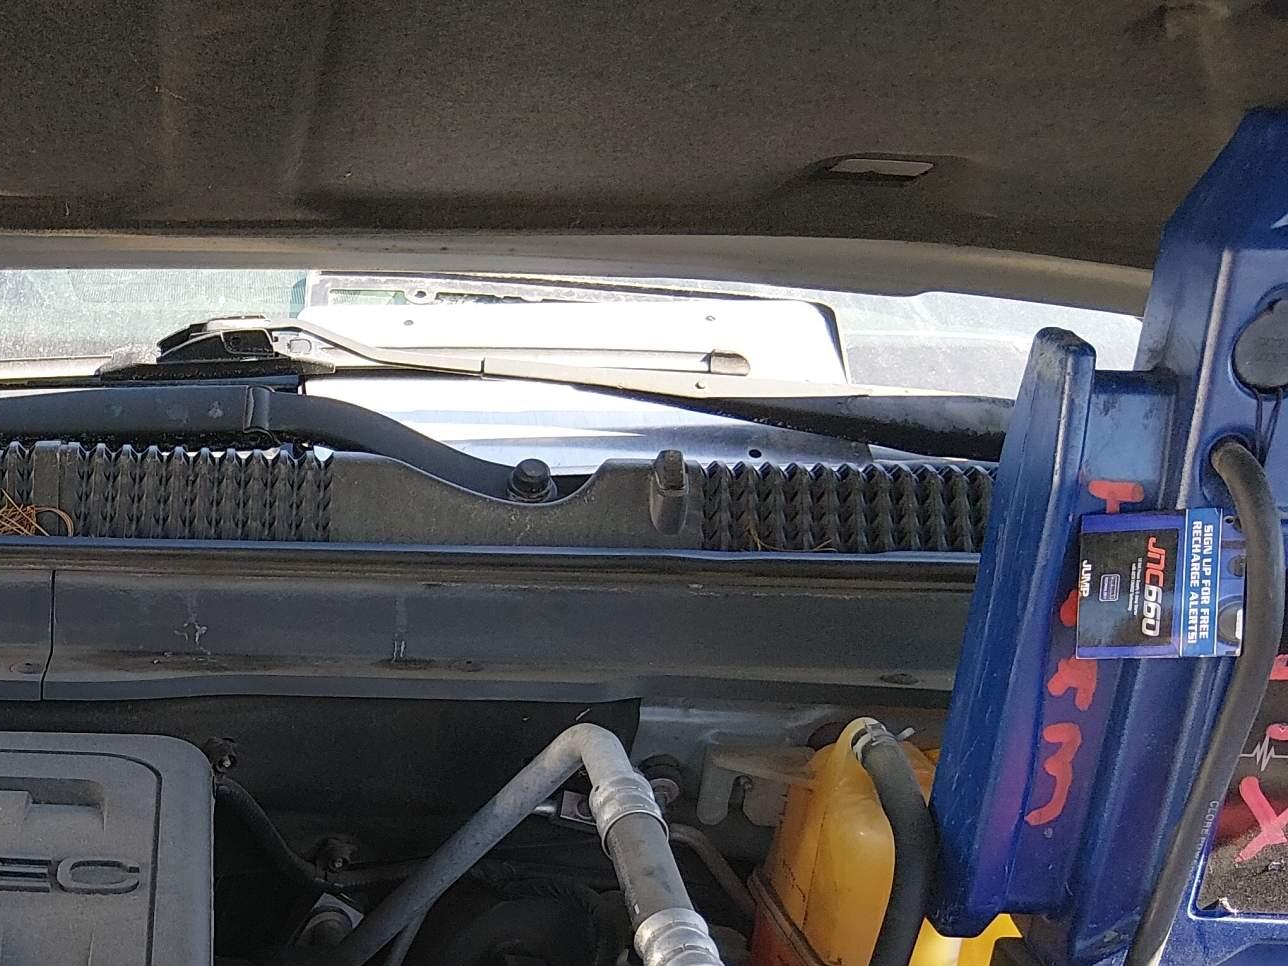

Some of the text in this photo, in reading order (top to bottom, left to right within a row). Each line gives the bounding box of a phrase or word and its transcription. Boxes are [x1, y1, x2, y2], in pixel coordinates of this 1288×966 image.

[1079, 559, 1092, 597] JUMP
[1141, 536, 1166, 637] JNC660
[1187, 521, 1203, 644] RECHARGE ALERTS!
[1199, 524, 1214, 639] SIGN UP FOR FREE
